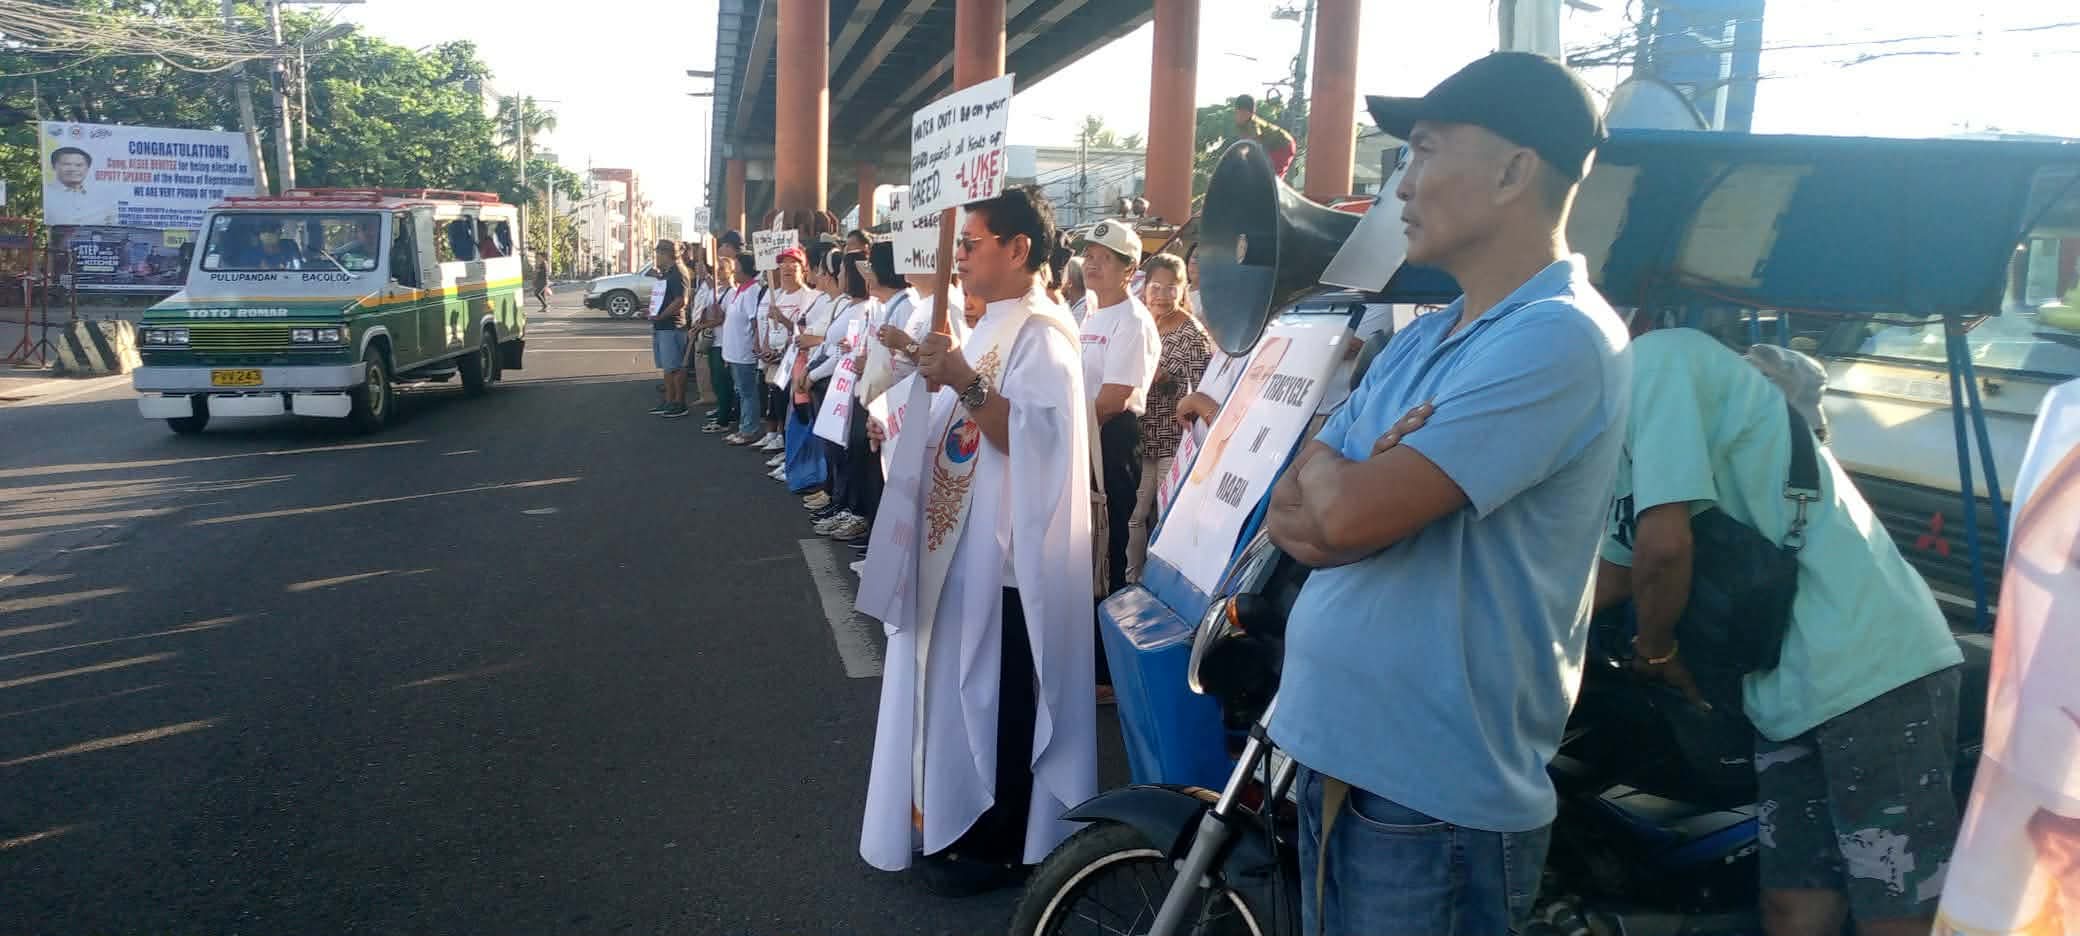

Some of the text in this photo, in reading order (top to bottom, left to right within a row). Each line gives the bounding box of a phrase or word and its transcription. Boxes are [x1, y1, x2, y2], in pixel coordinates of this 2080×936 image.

[128, 141, 229, 159] CONGRATULATIONS
[178, 161, 188, 171] for
[190, 161, 210, 172] being
[212, 162, 237, 174] elected
[210, 273, 278, 282] PULUPANDAN
[302, 273, 351, 282] BACOLOD
[187, 308, 288, 318] TOTO ROMAR
[1263, 374, 1315, 407] TRICYCLE
[1216, 472, 1249, 509] MARIA
